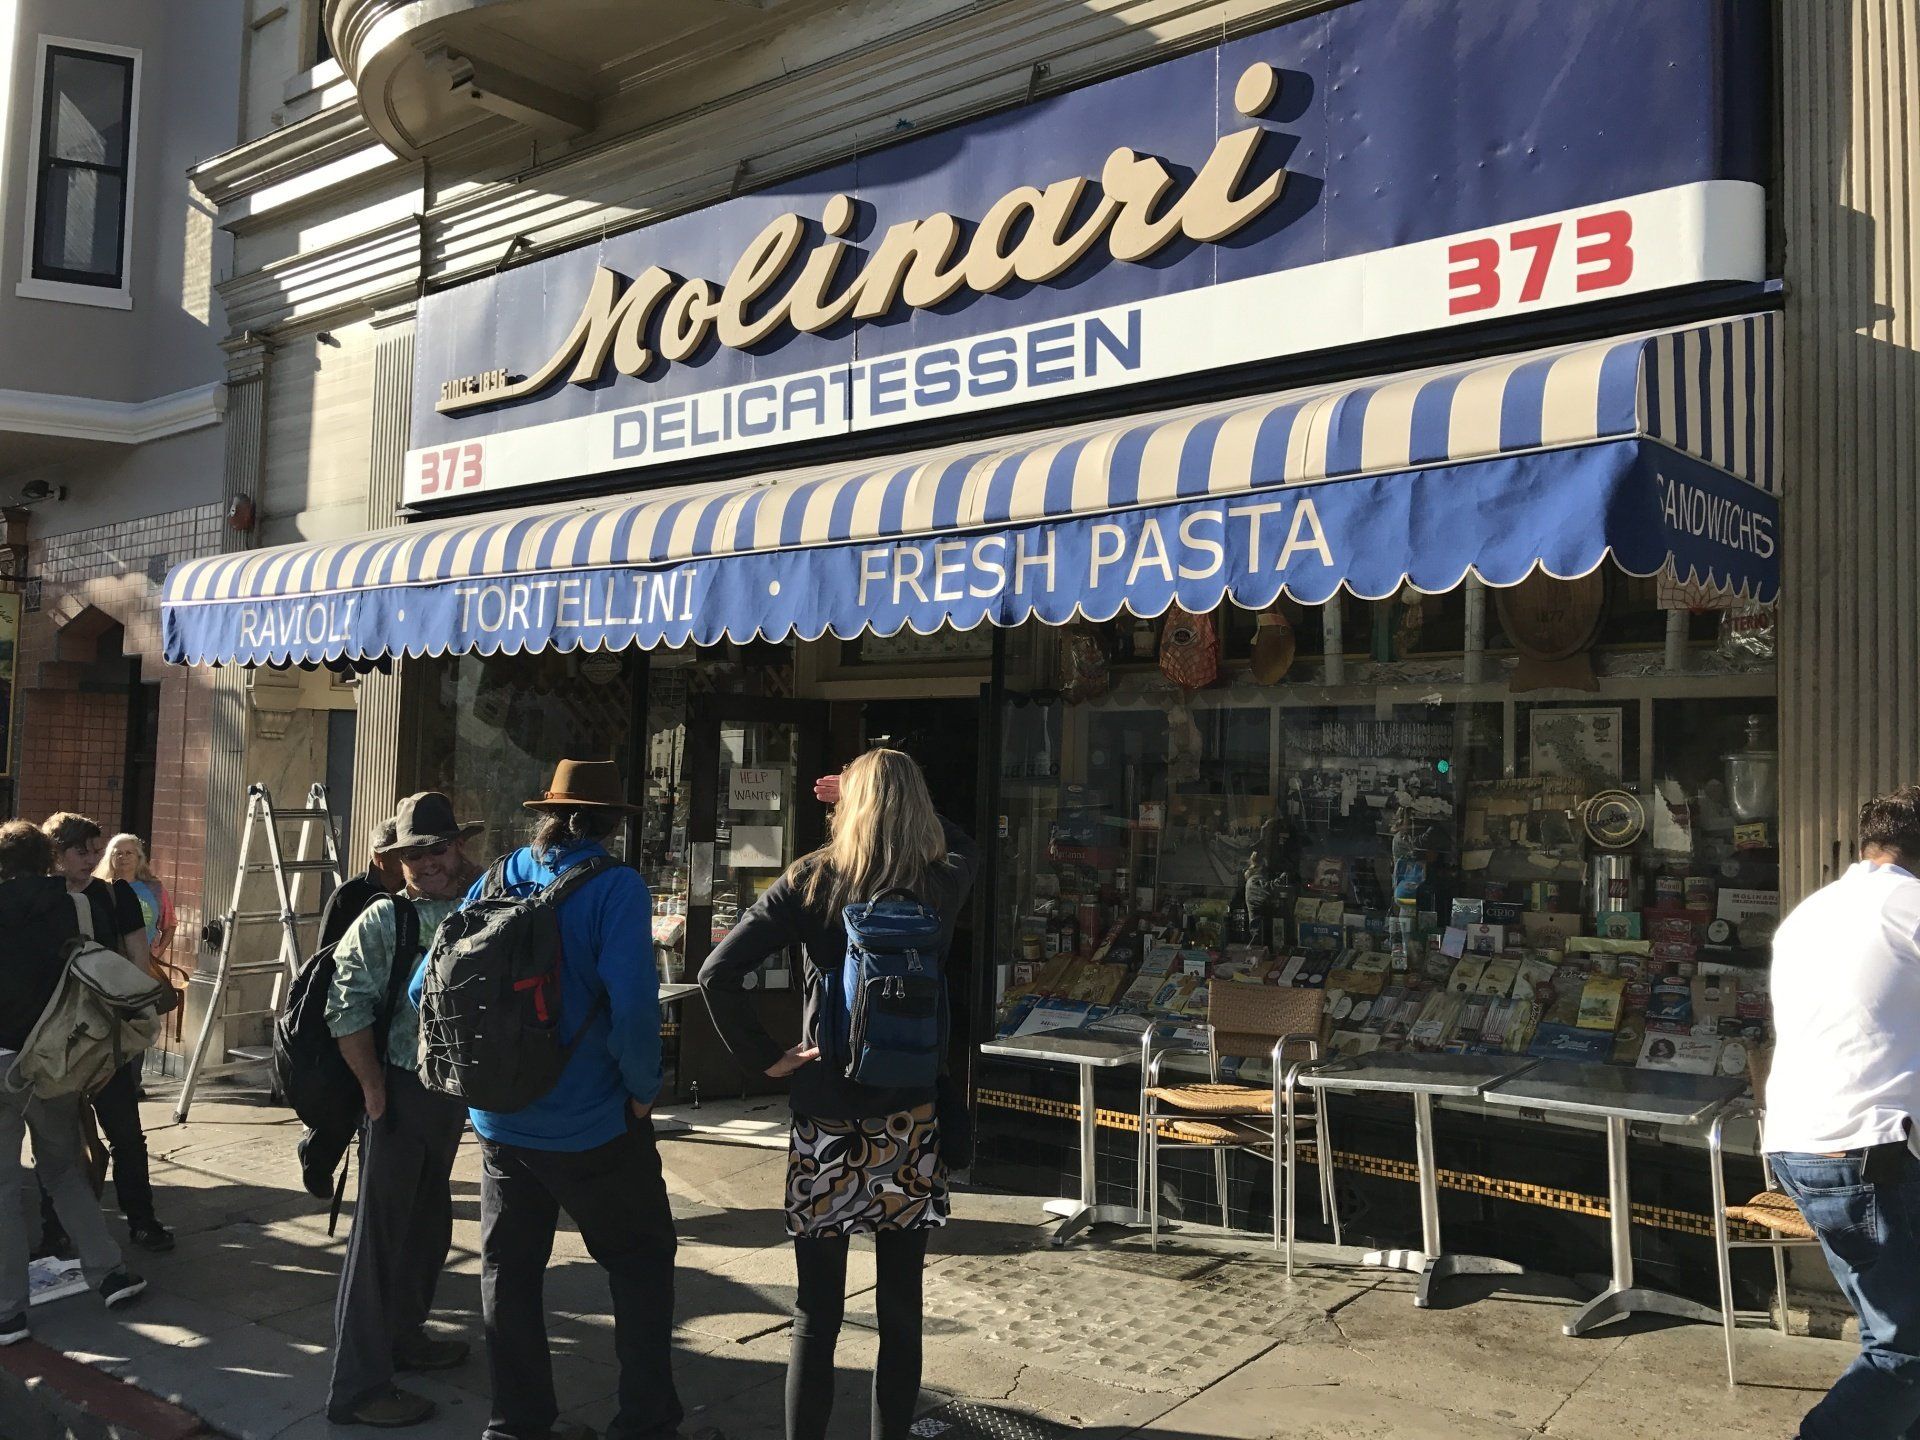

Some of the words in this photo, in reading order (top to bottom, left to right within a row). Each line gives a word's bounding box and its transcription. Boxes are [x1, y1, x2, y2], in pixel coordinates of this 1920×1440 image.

[498, 61, 1288, 392] Molinari
[1448, 208, 1635, 316] 373
[480, 368, 508, 393] 1896
[612, 308, 1142, 460] DELICATESSEN
[421, 443, 483, 494] 373
[858, 526, 1060, 610] FRESH
[1090, 498, 1336, 590] PASTA
[238, 597, 357, 649] RAVIOLI
[455, 568, 698, 633] TORTELLINI
[733, 790, 778, 801] WANTED
[739, 771, 768, 784] HELP
